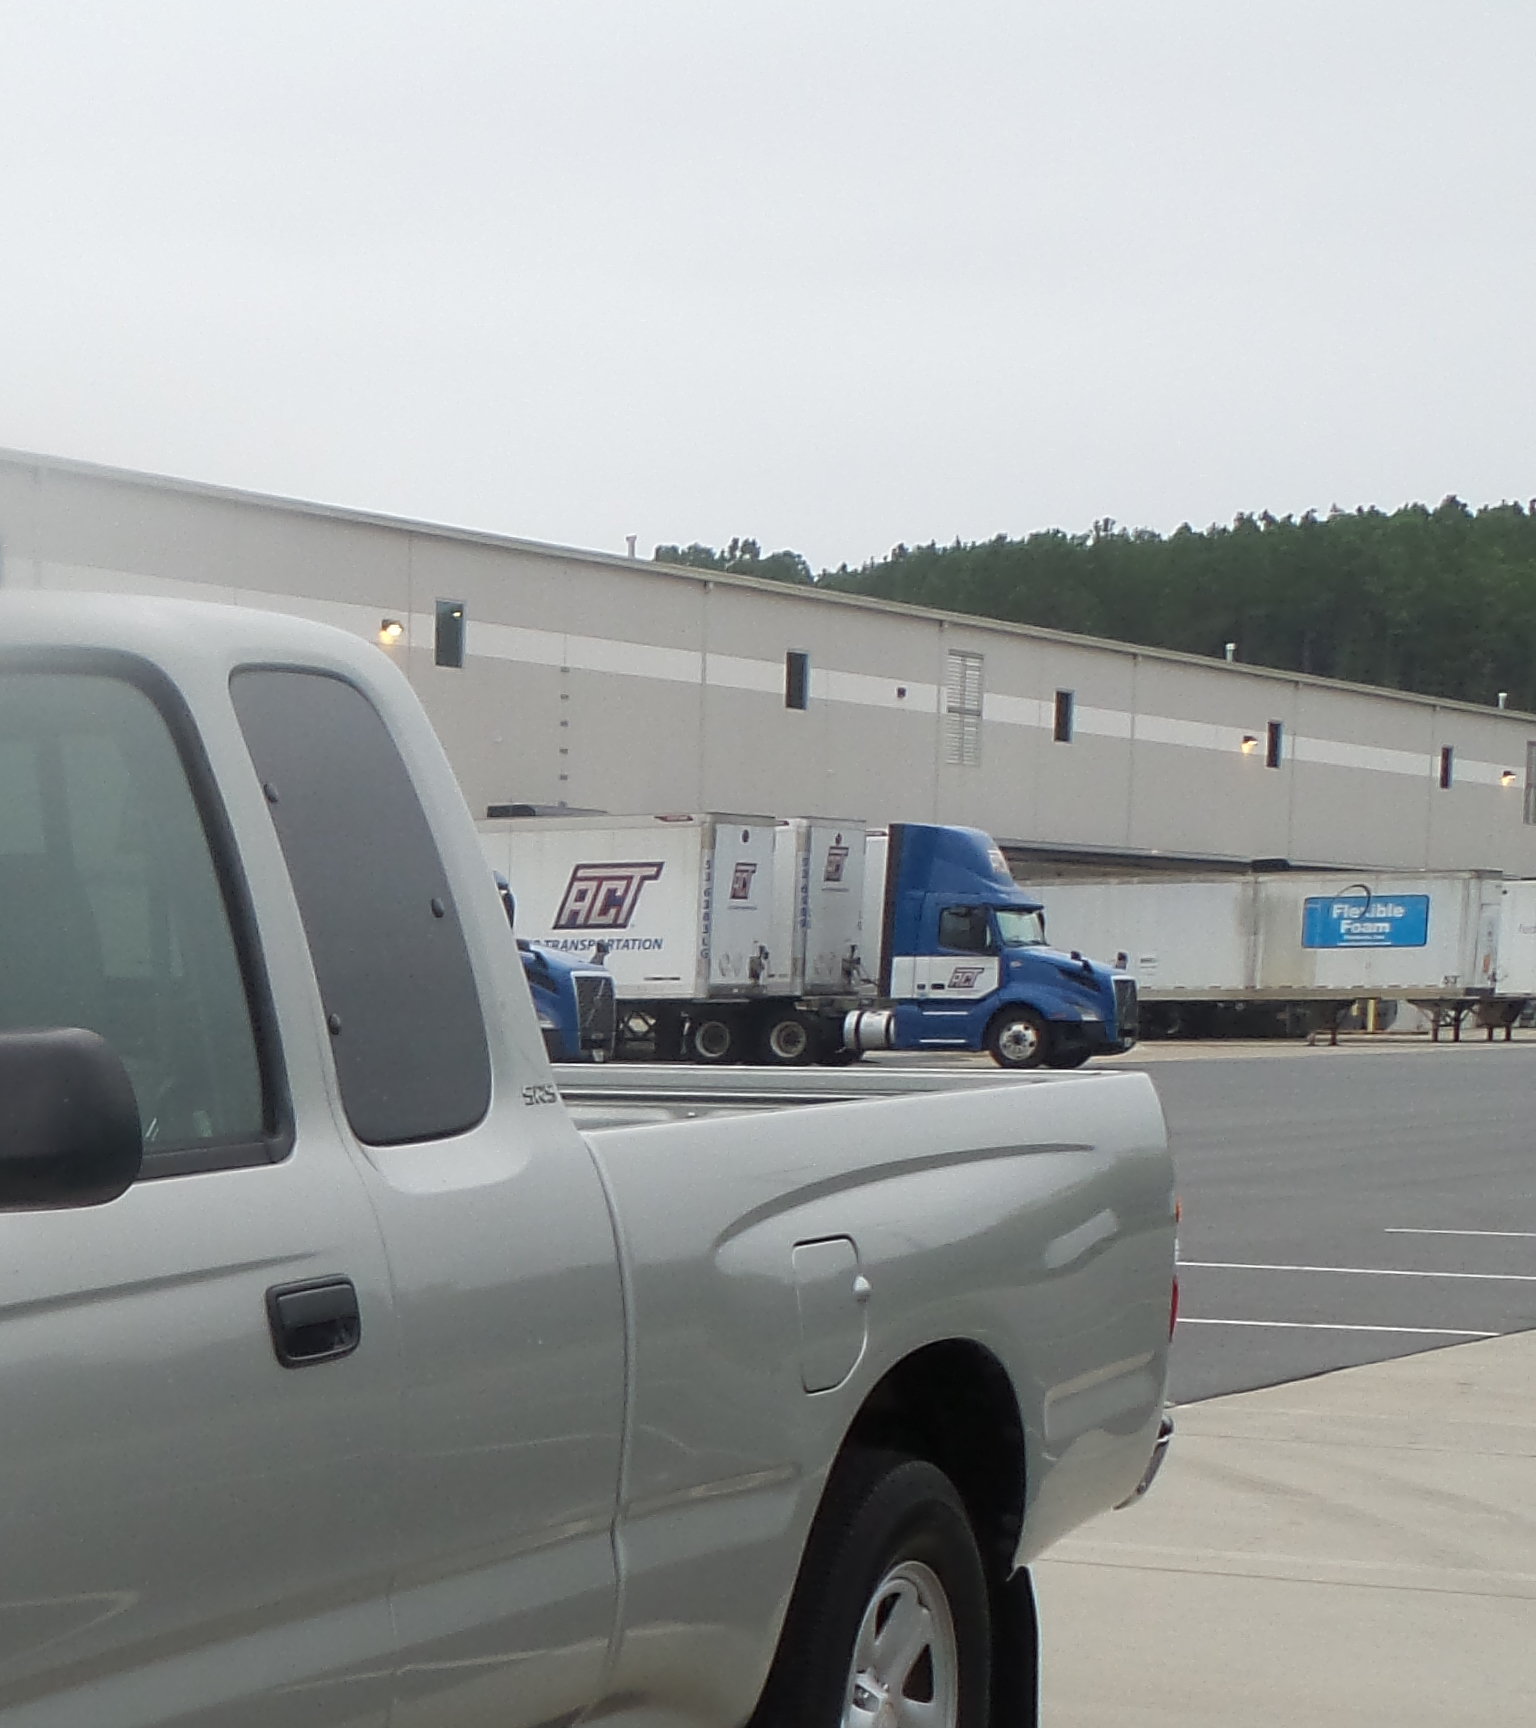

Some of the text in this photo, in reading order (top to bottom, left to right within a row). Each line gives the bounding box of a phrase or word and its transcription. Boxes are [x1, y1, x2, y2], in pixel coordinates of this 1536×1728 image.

[555, 862, 664, 929] ACT
[1332, 903, 1405, 918] Flexible
[1339, 919, 1392, 934] Foam
[543, 938, 664, 952] TRANSPRTATION
